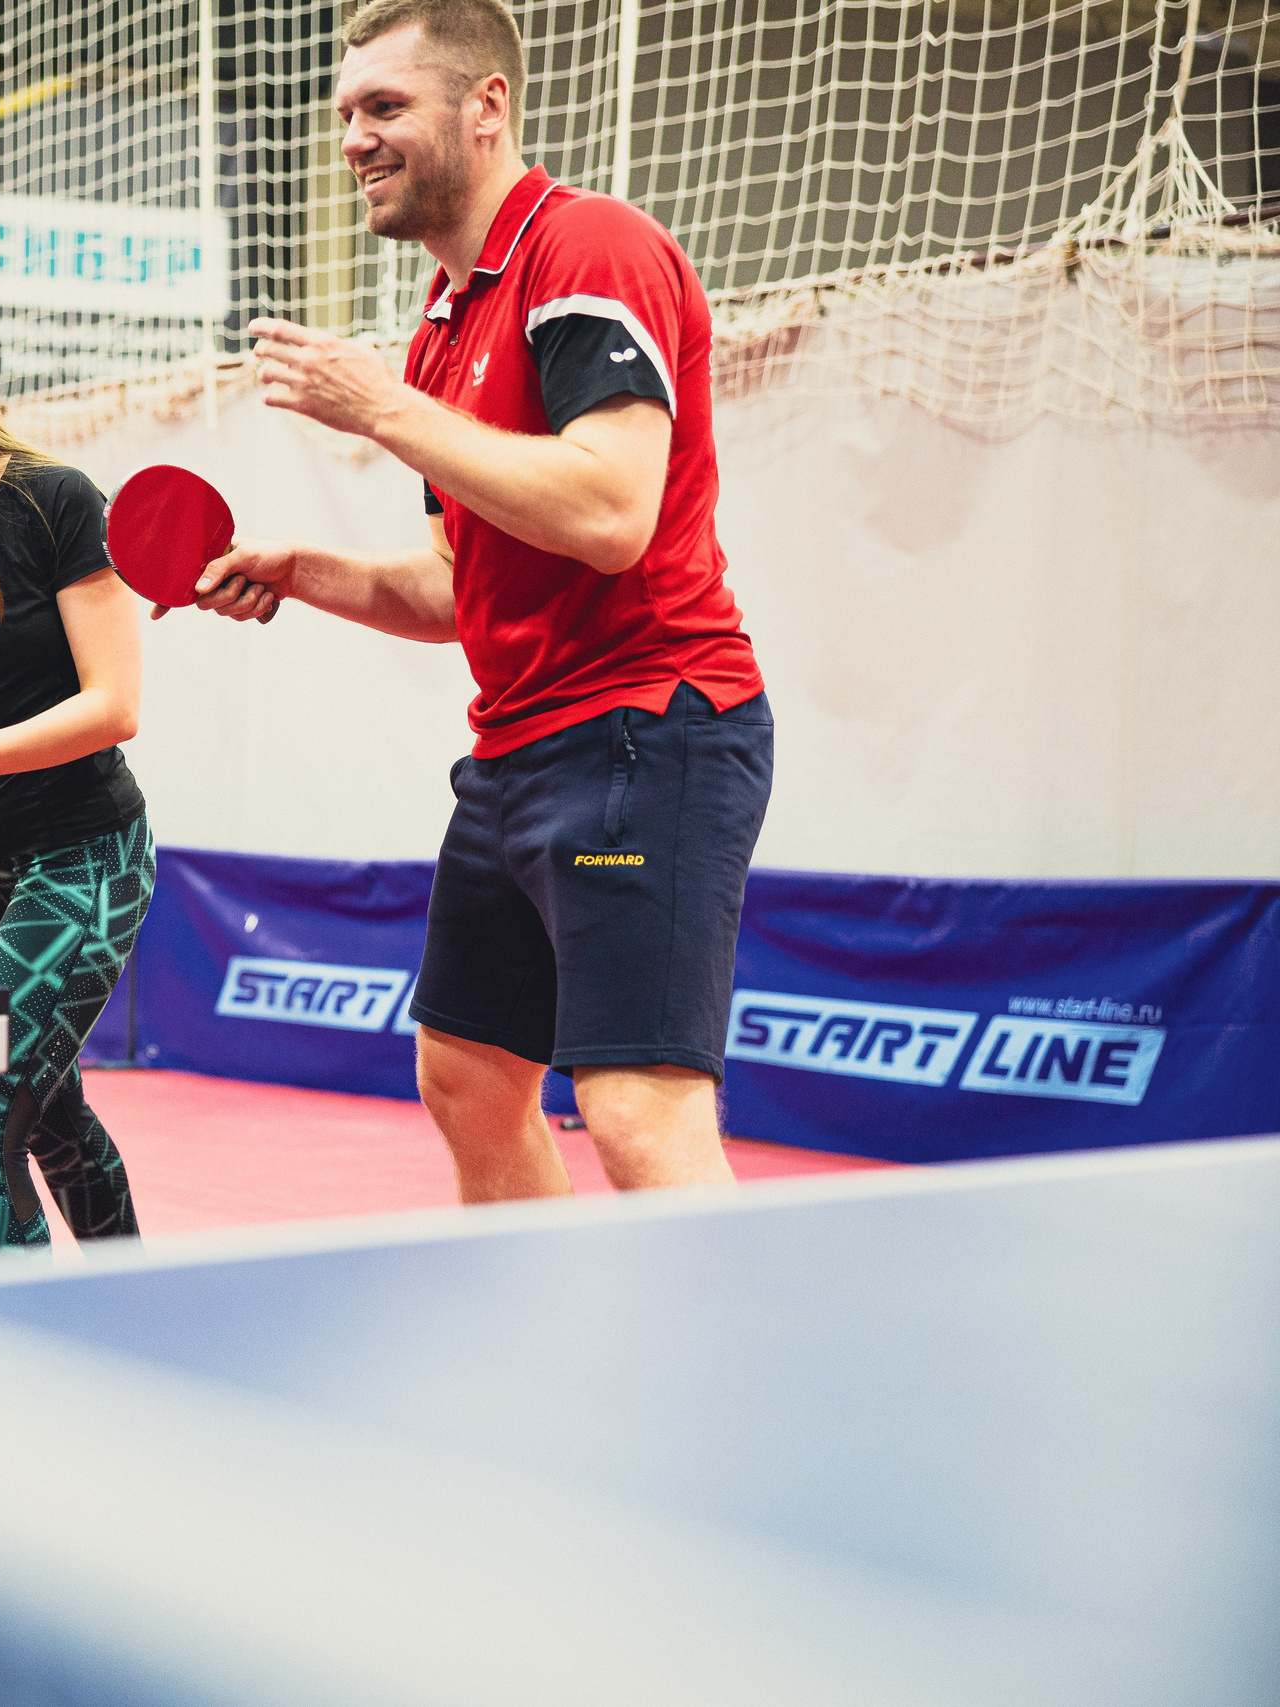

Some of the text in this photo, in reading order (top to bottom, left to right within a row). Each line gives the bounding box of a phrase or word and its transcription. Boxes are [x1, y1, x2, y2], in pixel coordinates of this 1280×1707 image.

[574, 854, 645, 867] FORWARD
[230, 969, 392, 1020] START
[1007, 996, 1163, 1024] www.start-line.ru
[737, 1006, 1140, 1088] START LINE
